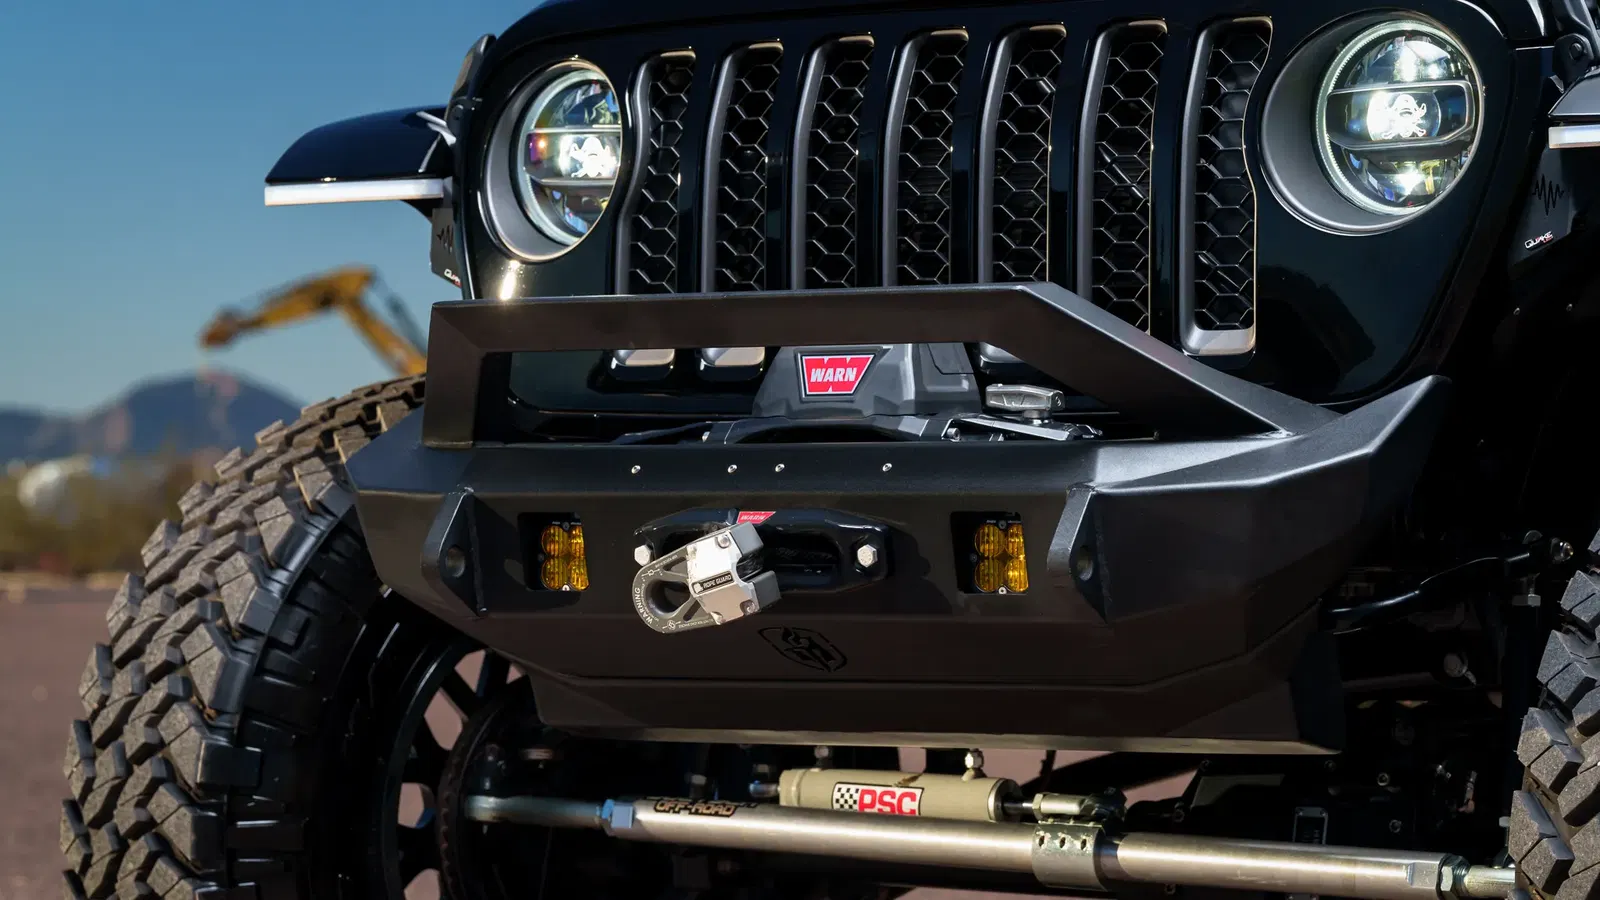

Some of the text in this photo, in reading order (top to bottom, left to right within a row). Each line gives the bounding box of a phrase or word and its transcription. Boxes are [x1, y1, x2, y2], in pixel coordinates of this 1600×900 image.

[810, 367, 858, 382] WARN
[703, 574, 732, 589] ROPE GUARD
[634, 587, 653, 624] WARNING
[655, 799, 736, 816] OFF-ROAD
[858, 788, 917, 816] PSC
